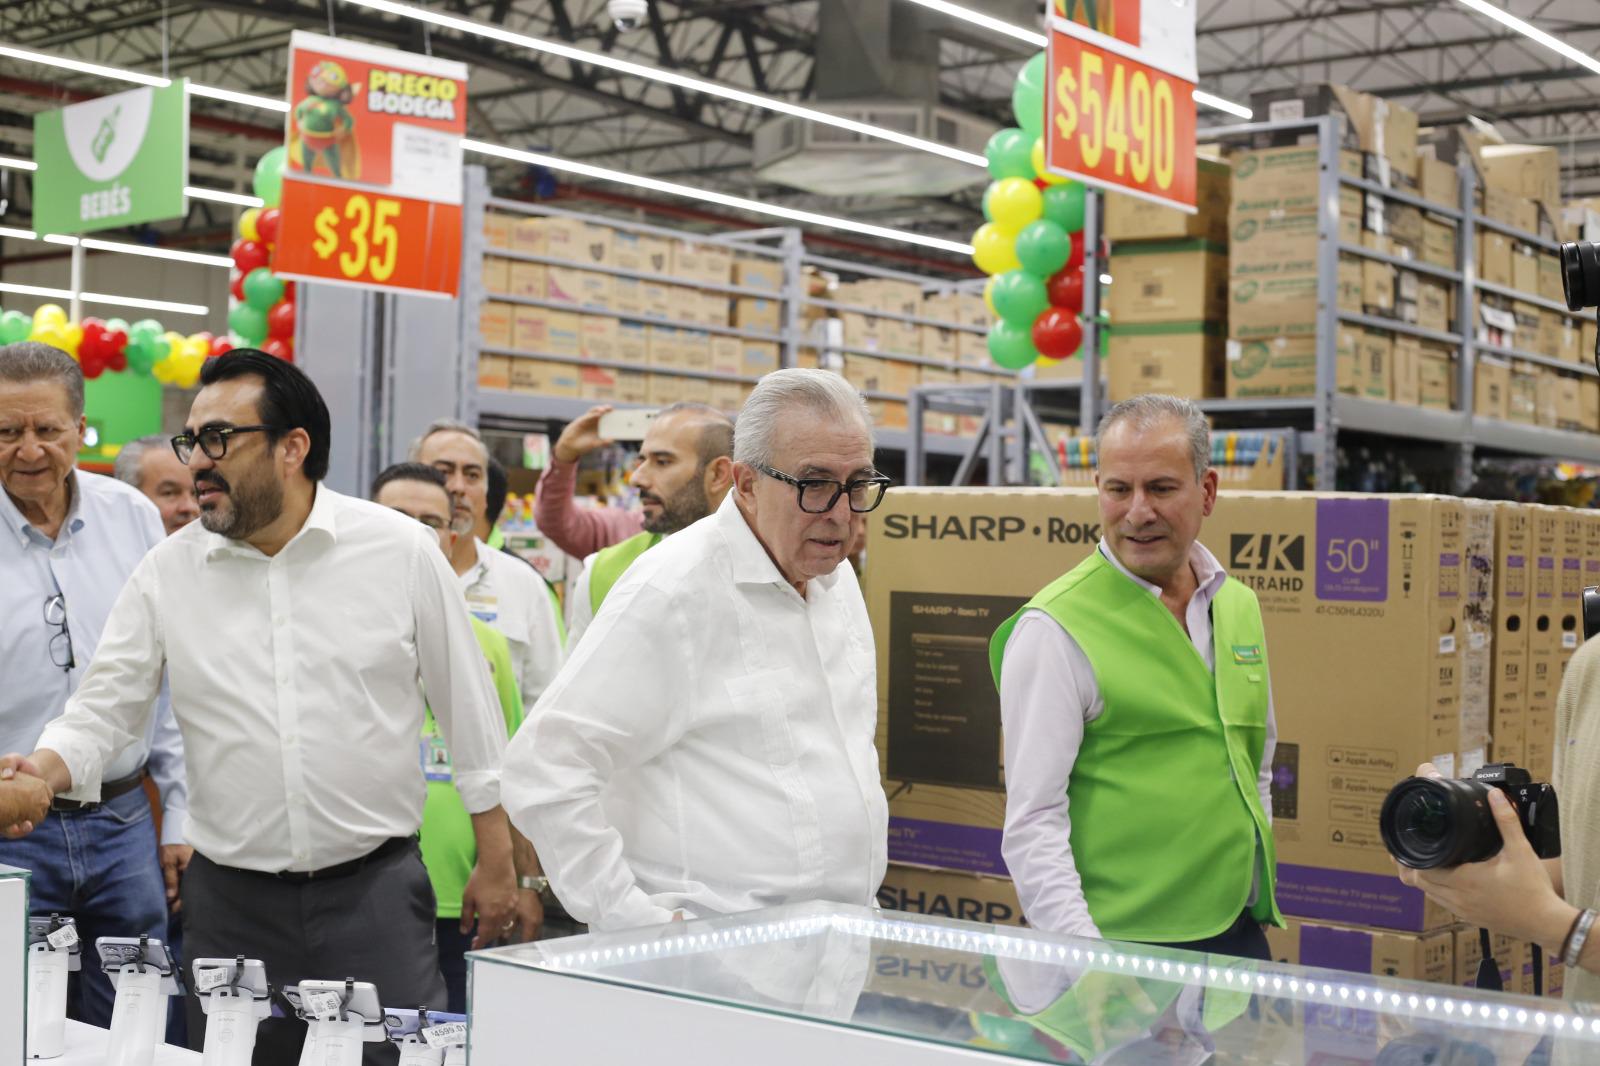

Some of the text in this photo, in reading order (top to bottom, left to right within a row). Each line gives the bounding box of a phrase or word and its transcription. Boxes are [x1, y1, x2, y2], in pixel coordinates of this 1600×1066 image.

[368, 69, 457, 101] PRECIO
[368, 92, 456, 120] BODEGA
[1055, 50, 1174, 190] $5490
[80, 182, 131, 221] BEBÉS
[312, 194, 401, 281] $35
[883, 514, 1026, 541] SHARP
[1231, 533, 1304, 571] 4K
[912, 605, 952, 615] SHARP
[978, 607, 990, 617] TV
[876, 886, 1012, 924] SHARP
